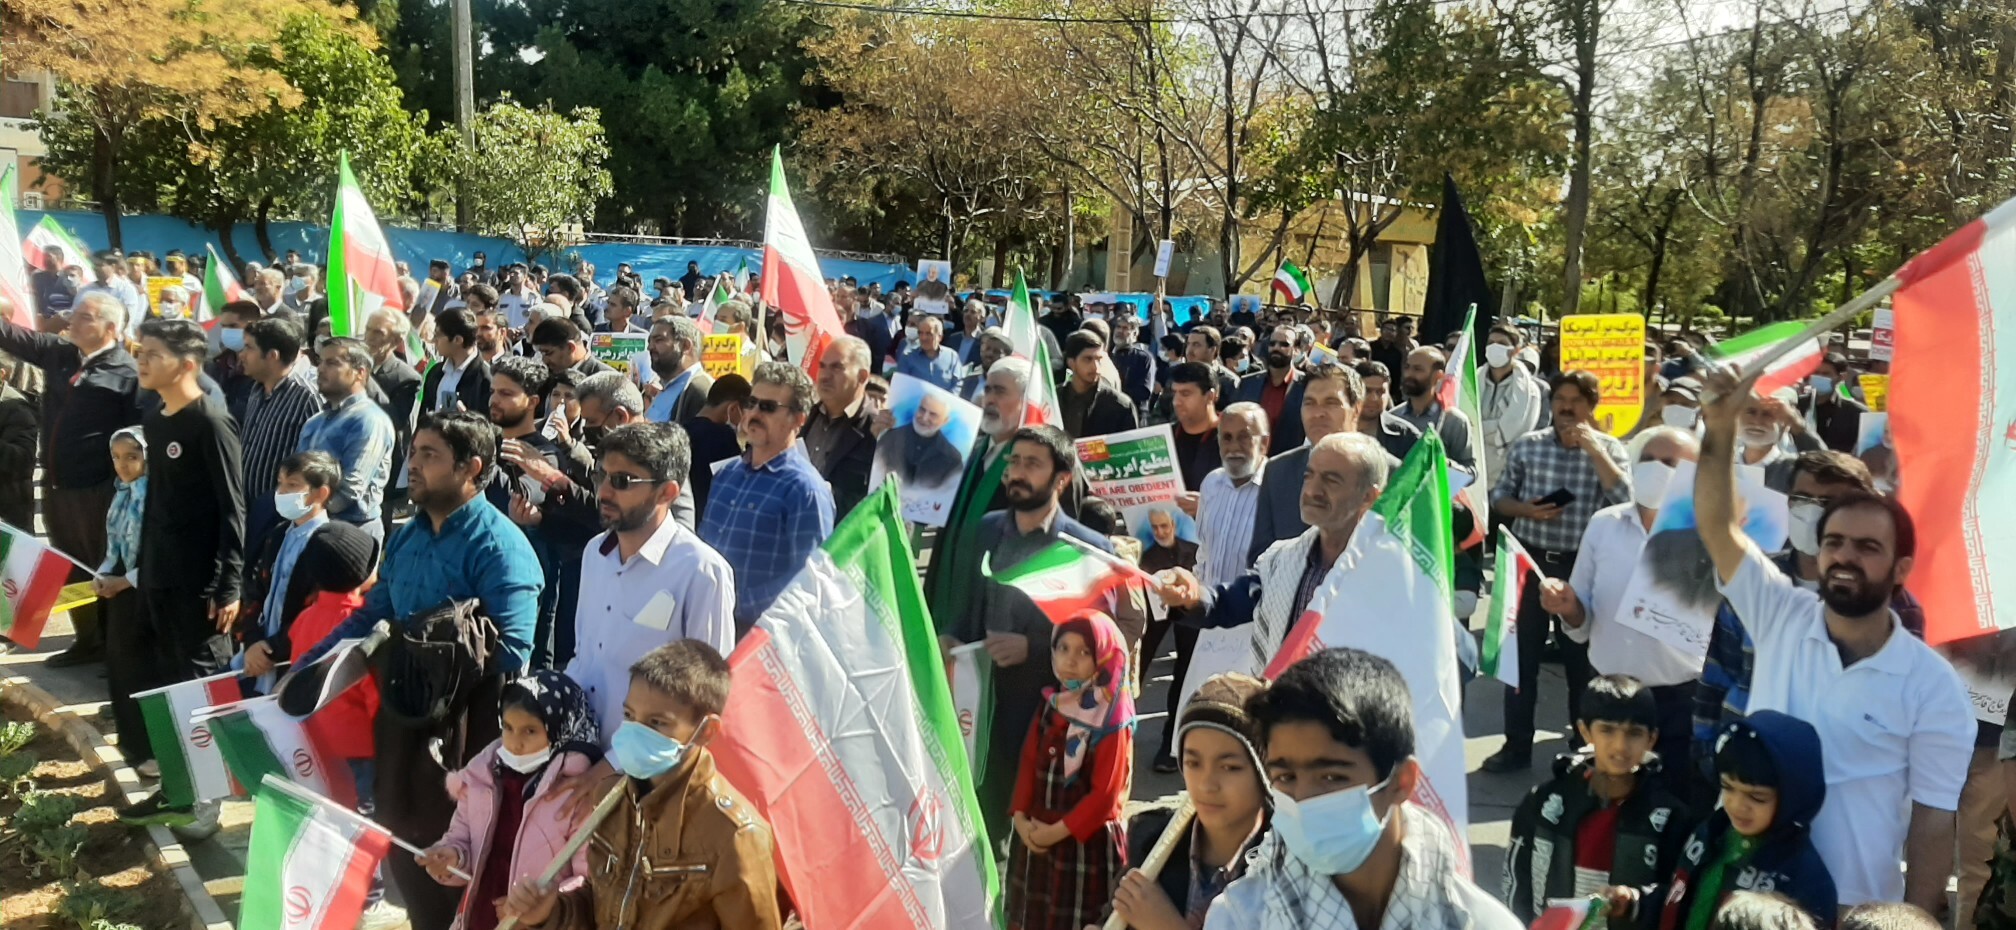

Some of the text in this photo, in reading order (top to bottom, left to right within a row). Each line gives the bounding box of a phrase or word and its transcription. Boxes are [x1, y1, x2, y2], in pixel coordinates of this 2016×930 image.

[1122, 456, 1138, 478] امر
[1139, 452, 1171, 476] مطیع
[1109, 485, 1126, 495] ARE
[1128, 479, 1176, 493] OBEDIENT
[1117, 497, 1135, 507] THE
